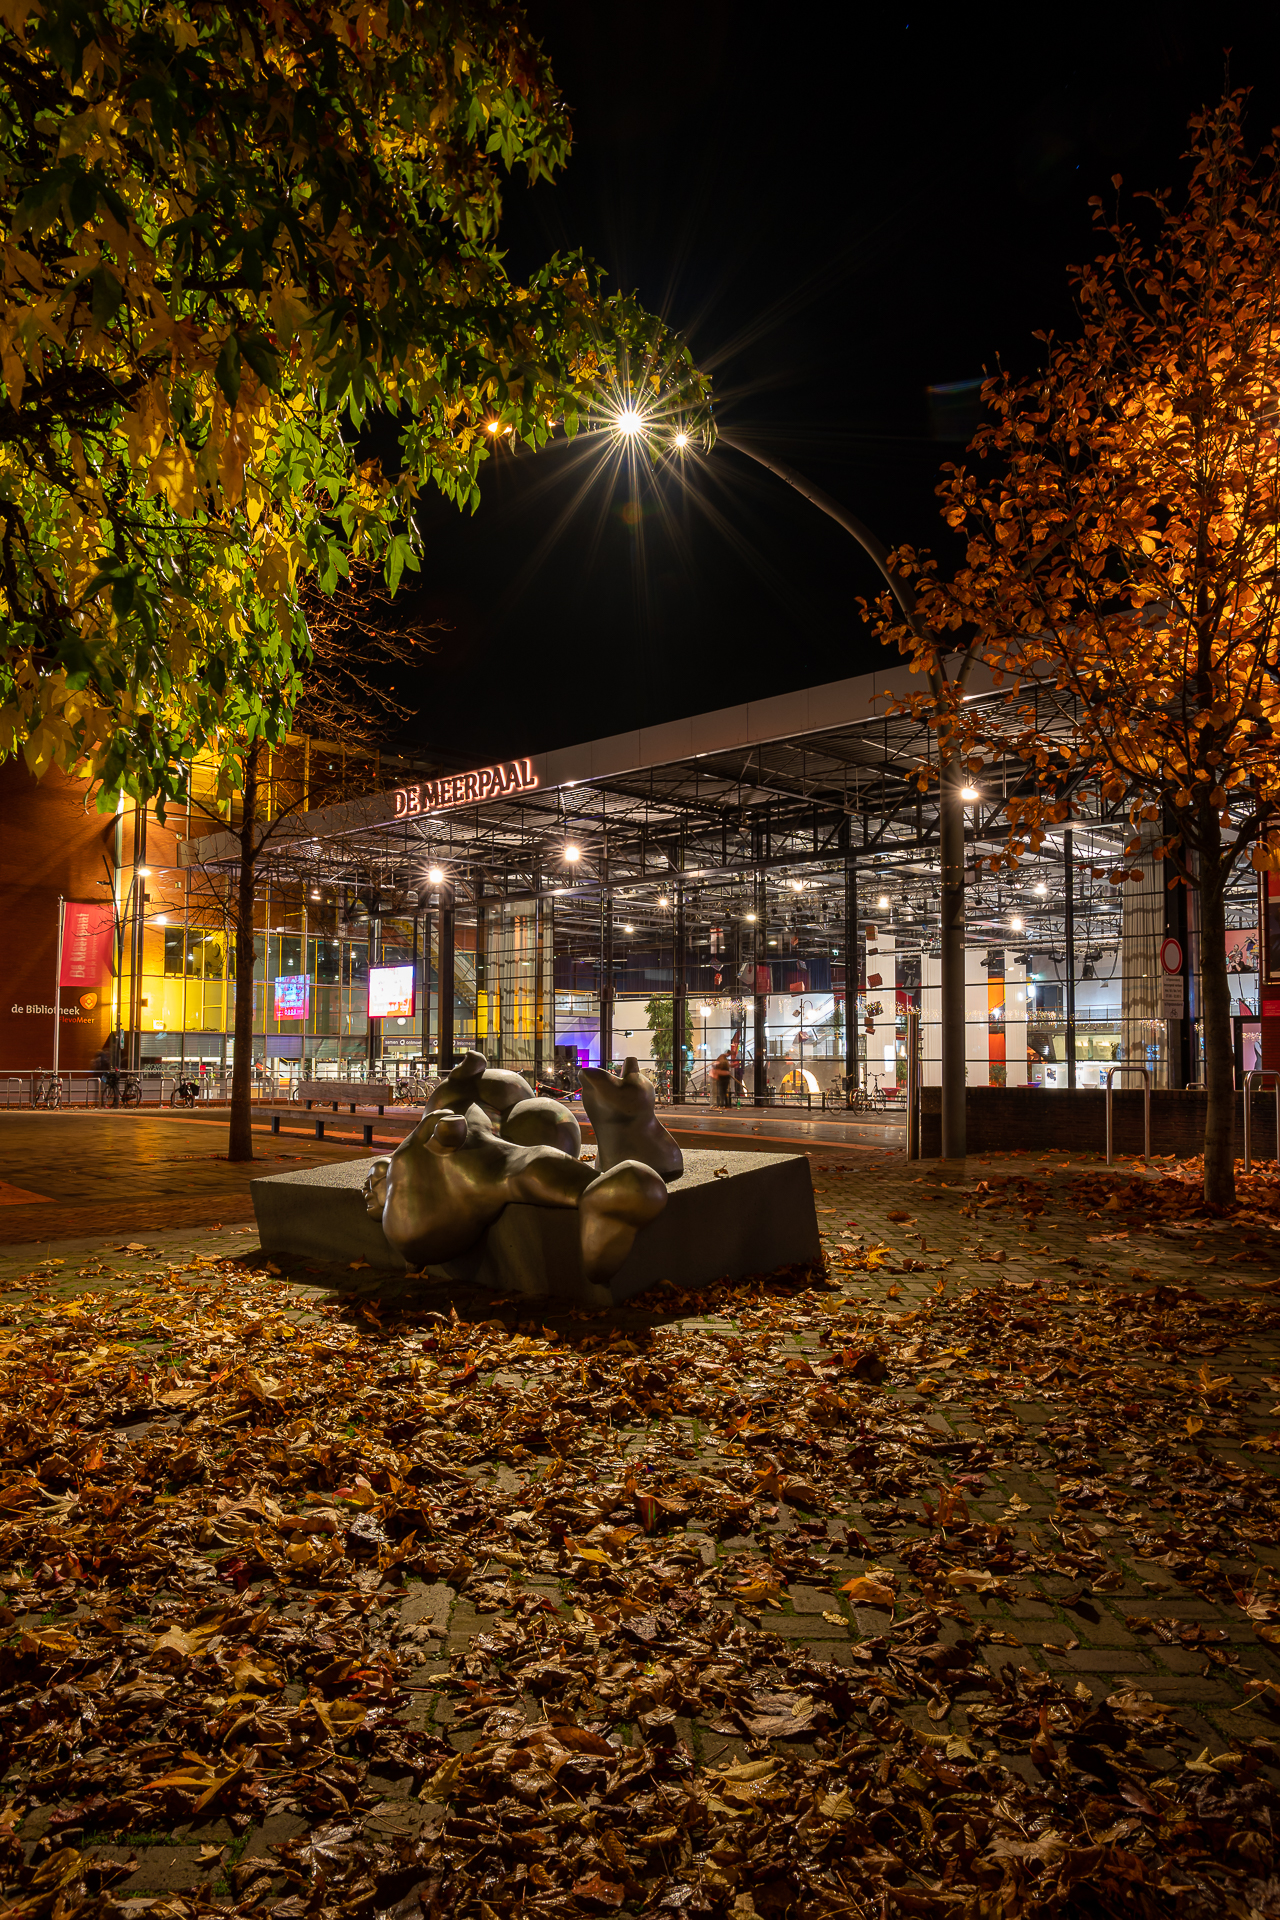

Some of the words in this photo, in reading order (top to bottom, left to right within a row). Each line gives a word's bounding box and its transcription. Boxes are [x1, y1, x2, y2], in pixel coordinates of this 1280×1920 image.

[394, 787, 421, 817] DE
[423, 759, 537, 810] MEERPAAL
[69, 912, 90, 962] Meerpaal
[69, 964, 86, 978] De
[11, 1004, 24, 1014] de
